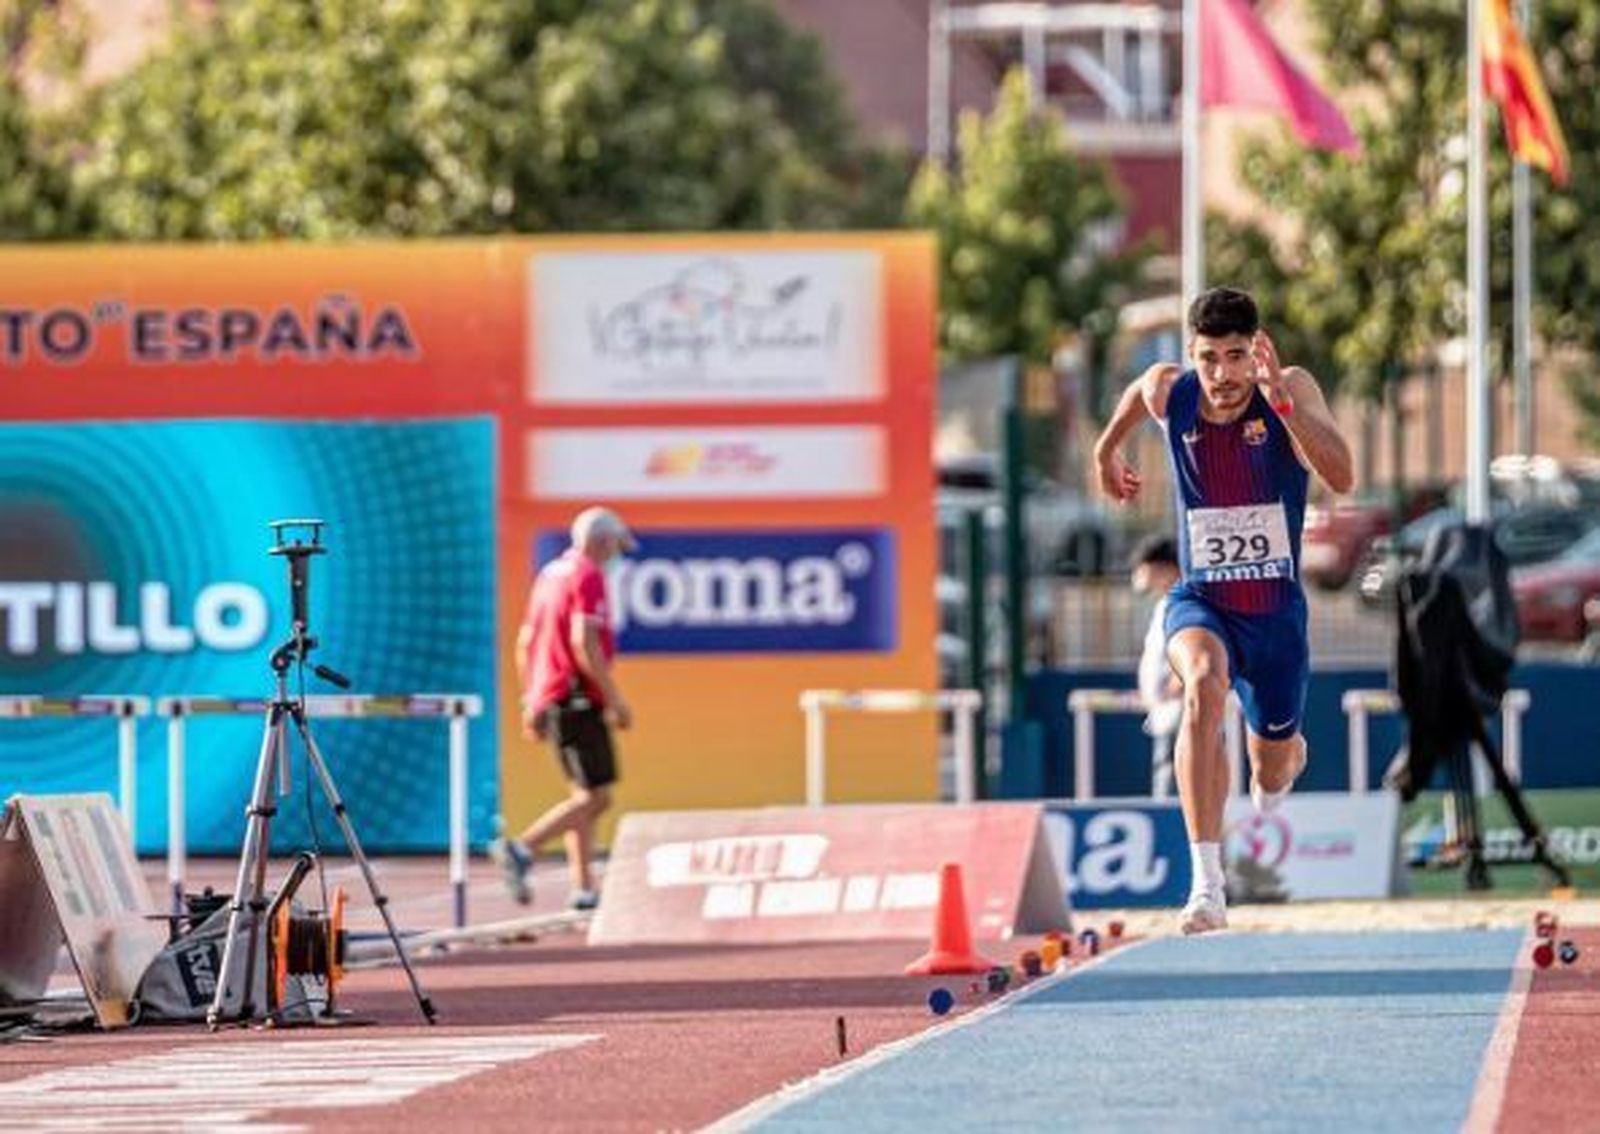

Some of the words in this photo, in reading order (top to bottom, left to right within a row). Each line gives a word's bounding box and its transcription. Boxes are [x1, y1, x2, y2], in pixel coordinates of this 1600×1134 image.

[0, 307, 91, 363] TO
[132, 295, 418, 362] ESPAÑA
[1206, 533, 1270, 566] 329
[0, 580, 269, 655] TILLO
